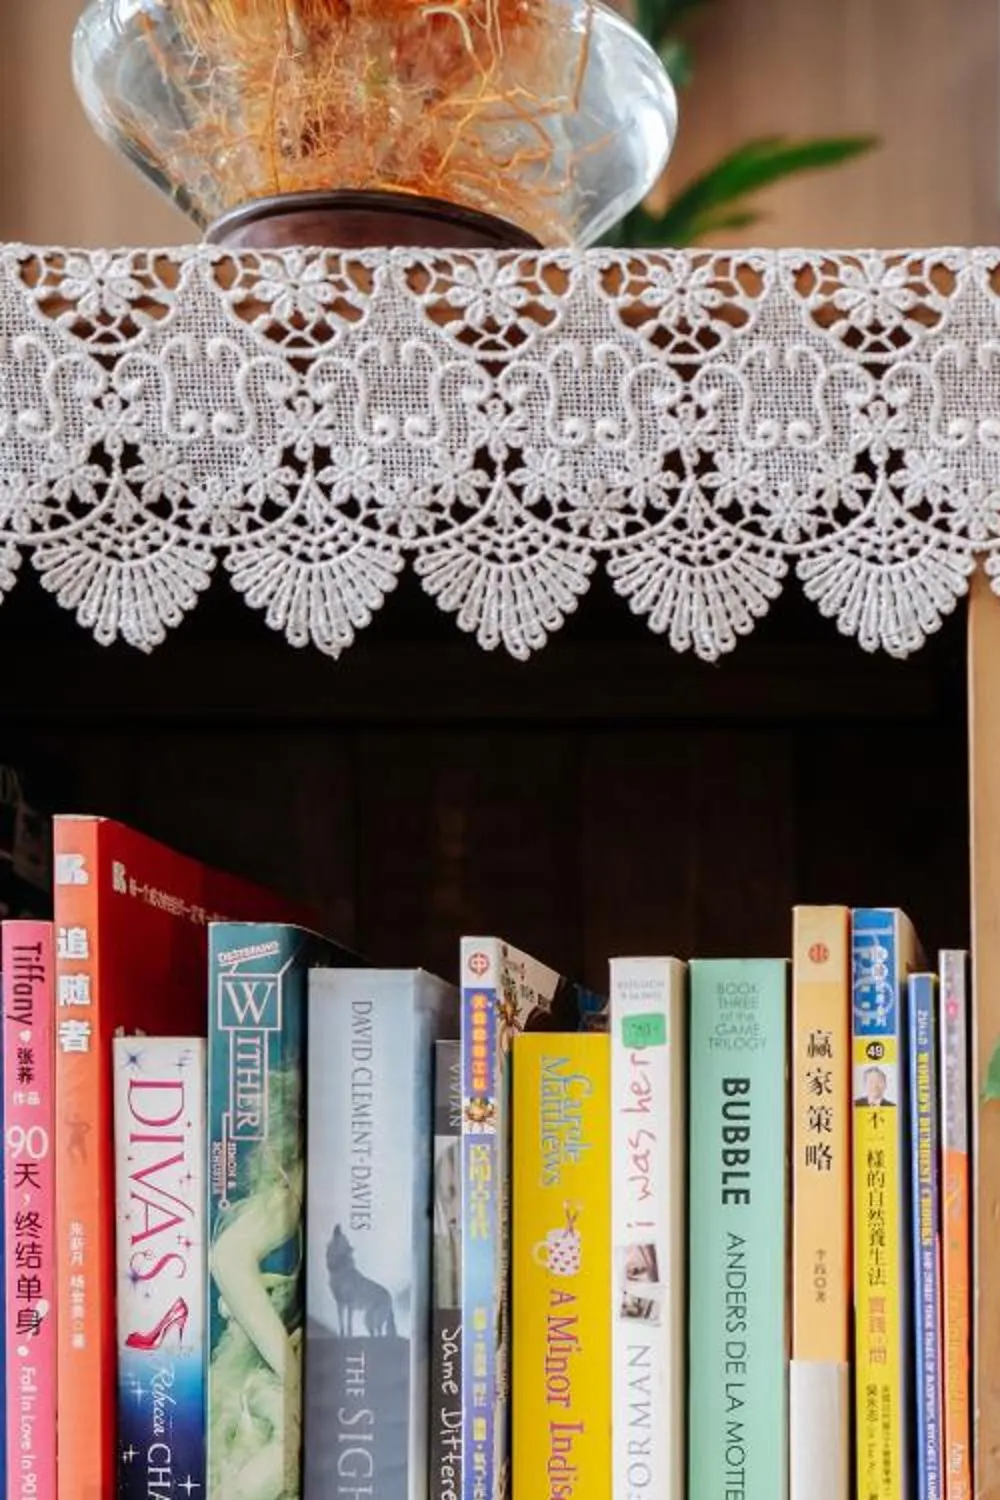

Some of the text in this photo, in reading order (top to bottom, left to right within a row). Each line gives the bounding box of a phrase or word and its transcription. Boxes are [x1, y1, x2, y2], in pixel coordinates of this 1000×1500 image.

[7, 942, 45, 1026] Tiffany
[56, 927, 91, 1053] 追随者
[717, 982, 757, 994] BOOK
[718, 995, 760, 1009] THREE
[709, 1037, 767, 1050] TRILOGY
[715, 1023, 760, 1037] GAME
[866, 1045, 883, 1057] 49
[622, 1046, 653, 1114] her
[805, 1029, 833, 1172] 贏家策略
[350, 1001, 373, 1232] DAVID CLEMENT-DAVIES
[540, 1055, 571, 1187] Matthews
[562, 1073, 593, 1163] Carole
[721, 1077, 751, 1206] BUBBLE
[127, 1079, 194, 1280] DIVAS
[628, 1129, 656, 1201] was
[549, 1289, 577, 1307] A
[725, 1231, 747, 1334] ANDERS
[20, 1365, 37, 1391] Fall
[345, 1351, 365, 1397] THE
[441, 1327, 463, 1395] Same
[545, 1314, 582, 1408] Minor
[725, 1341, 747, 1374] DE
[20, 1414, 35, 1450] Love
[150, 1362, 176, 1437] Rebecca
[725, 1383, 747, 1413] LA
[20, 1472, 38, 1493] 90
